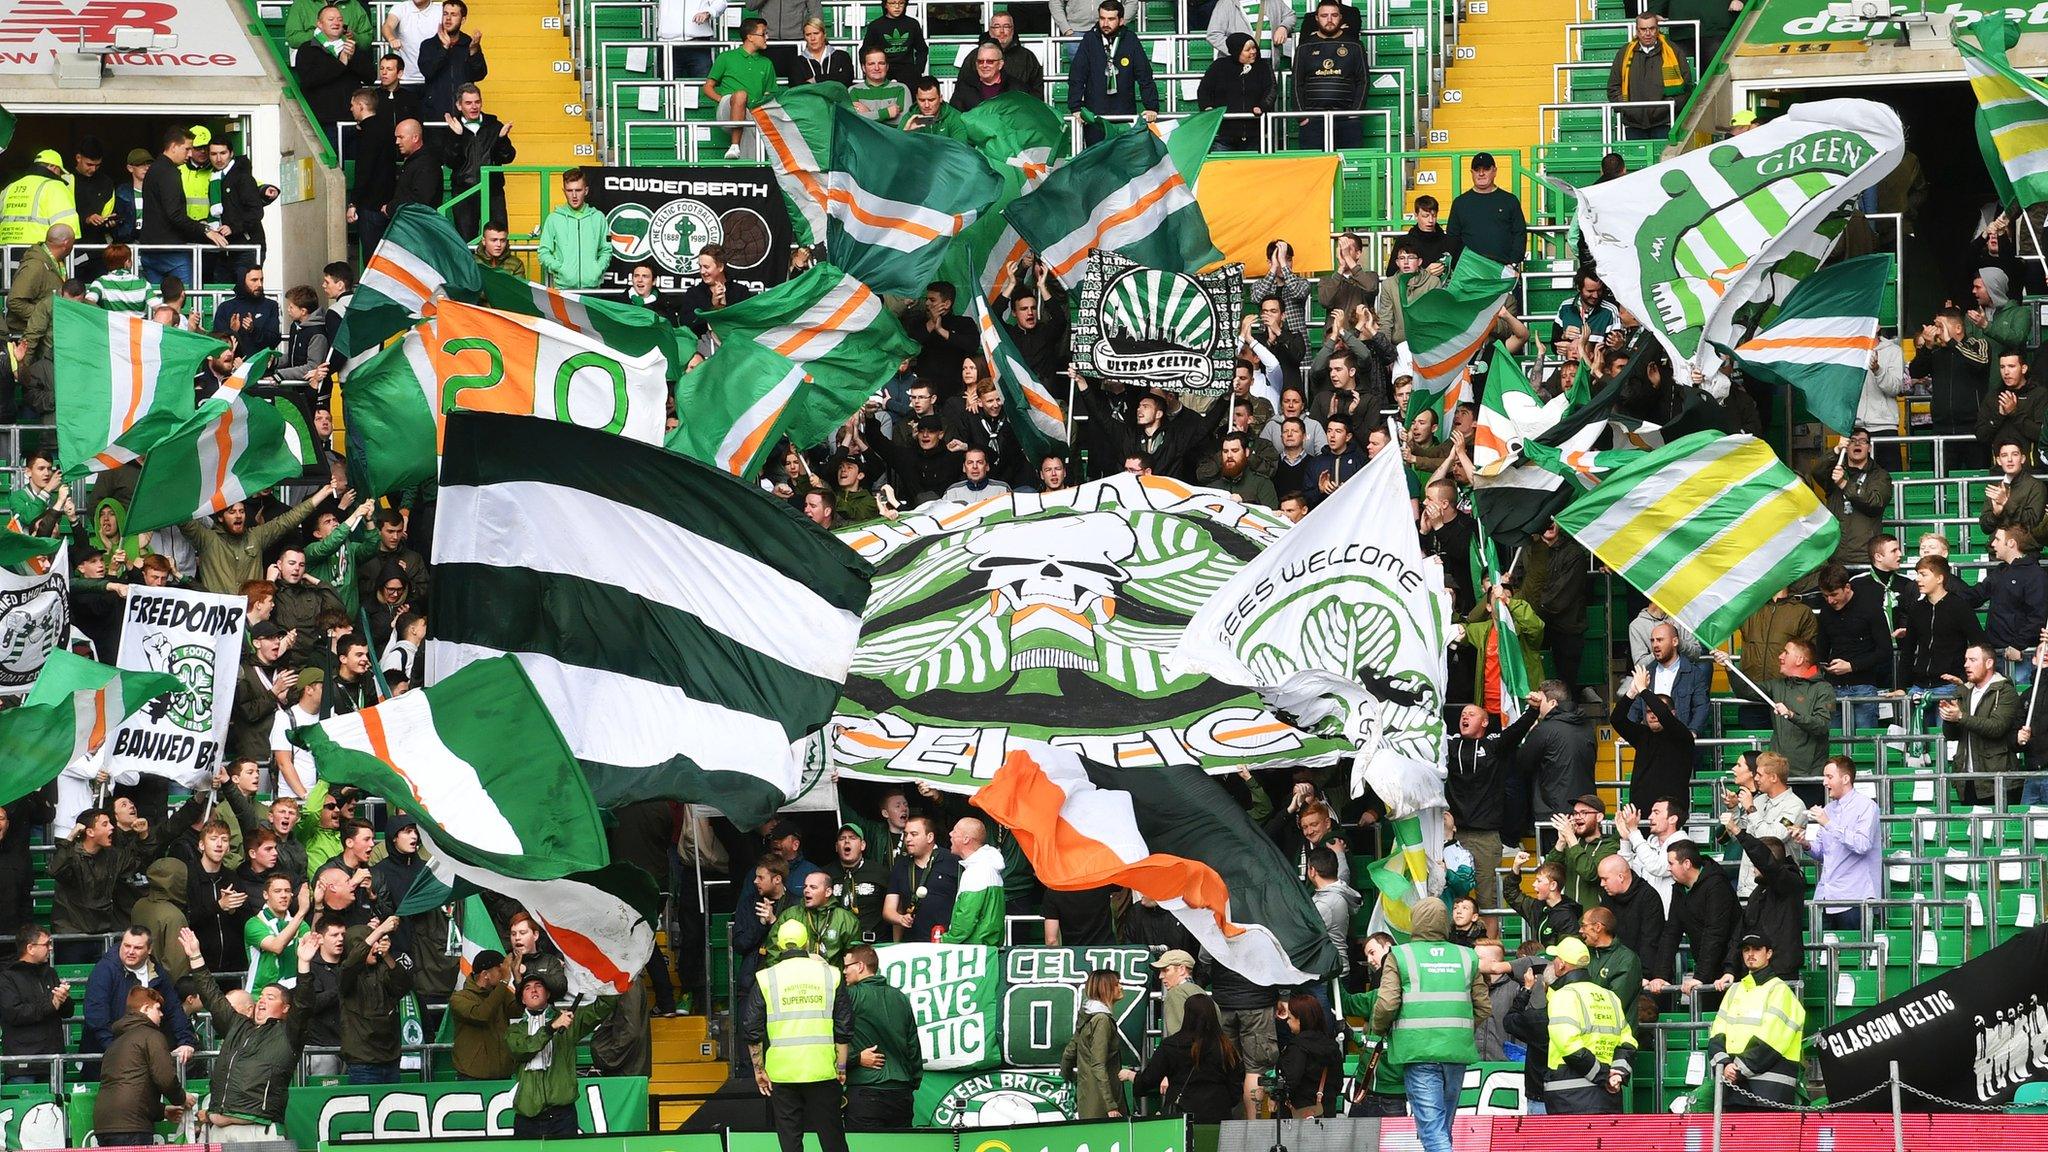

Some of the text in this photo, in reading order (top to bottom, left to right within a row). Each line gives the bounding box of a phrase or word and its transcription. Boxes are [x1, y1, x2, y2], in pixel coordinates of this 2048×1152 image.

[1470, 2, 1486, 13] EE
[543, 18, 560, 28] EE
[0, 53, 38, 64] ew
[1456, 48, 1474, 59] DD
[554, 62, 571, 72] DD
[1443, 91, 1462, 102] CC
[564, 105, 582, 115] CC
[1430, 131, 1448, 142] BB
[576, 145, 593, 155] BB
[1756, 137, 1862, 175] GREEN
[1418, 172, 1435, 183] AA
[604, 176, 769, 198] COWDENBEATH
[652, 228, 660, 244] THE
[657, 206, 676, 227] CELTIC
[676, 204, 713, 225] FOOTBALL
[663, 234, 680, 242] 1888
[1107, 355, 1202, 372] ULTRAS CELTIC
[1281, 543, 1424, 593] WELCOME
[1601, 729, 1611, 741] M
[112, 728, 195, 763] BANNED
[876, 947, 978, 993] ORTH
[1008, 949, 1150, 983] CELTIC
[782, 995, 823, 1006] SUPERVISOR
[1003, 983, 1148, 1066] OK
[1827, 988, 1956, 1059] GLASGOW CELTIC
[702, 1043, 711, 1056] E
[935, 1073, 994, 1126] GREEN
